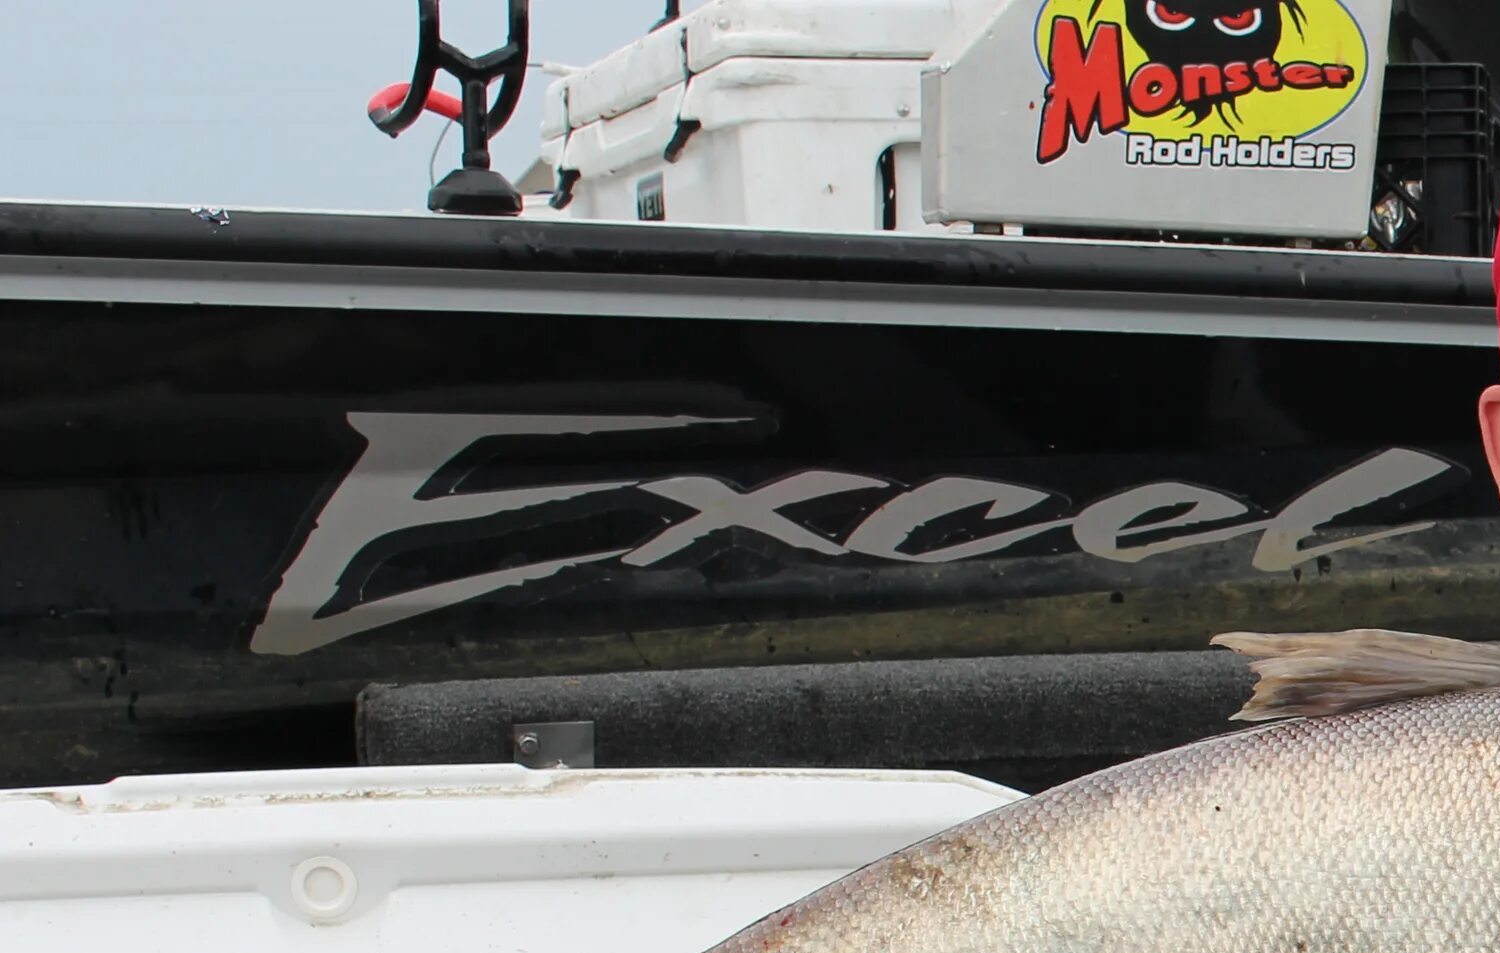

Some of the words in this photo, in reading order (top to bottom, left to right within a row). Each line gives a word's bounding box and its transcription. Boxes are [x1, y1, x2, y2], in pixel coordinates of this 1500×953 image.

[1038, 16, 1354, 164] Monster
[1126, 134, 1202, 165] Rod
[1210, 136, 1356, 169] Holders
[250, 411, 1453, 656] Excel
